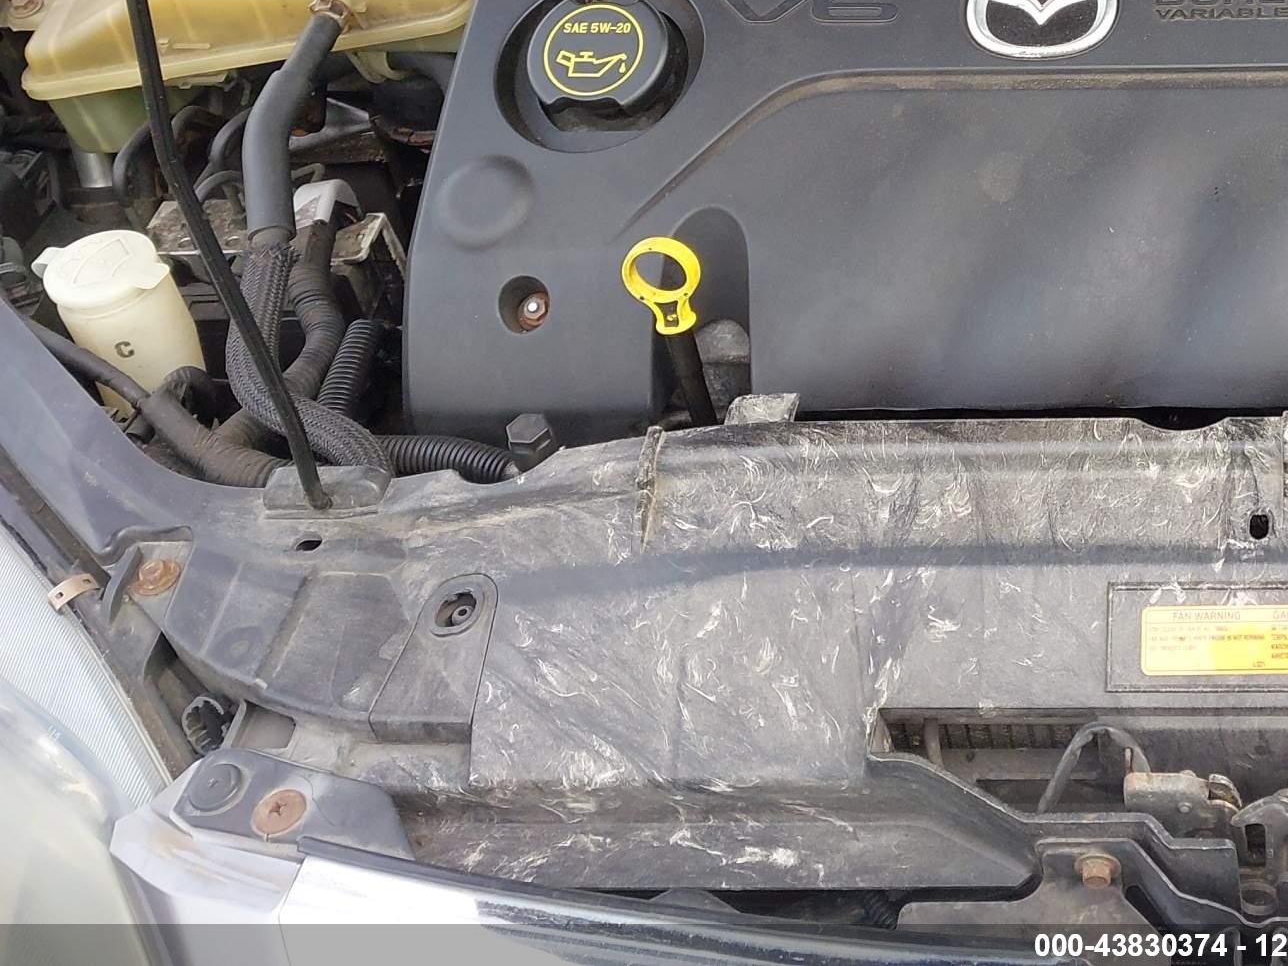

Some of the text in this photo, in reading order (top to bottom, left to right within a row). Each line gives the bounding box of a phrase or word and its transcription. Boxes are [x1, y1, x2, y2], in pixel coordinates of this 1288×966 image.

[563, 22, 631, 34] SAE 5W-20
[1173, 611, 1241, 621] FAN WARNING
